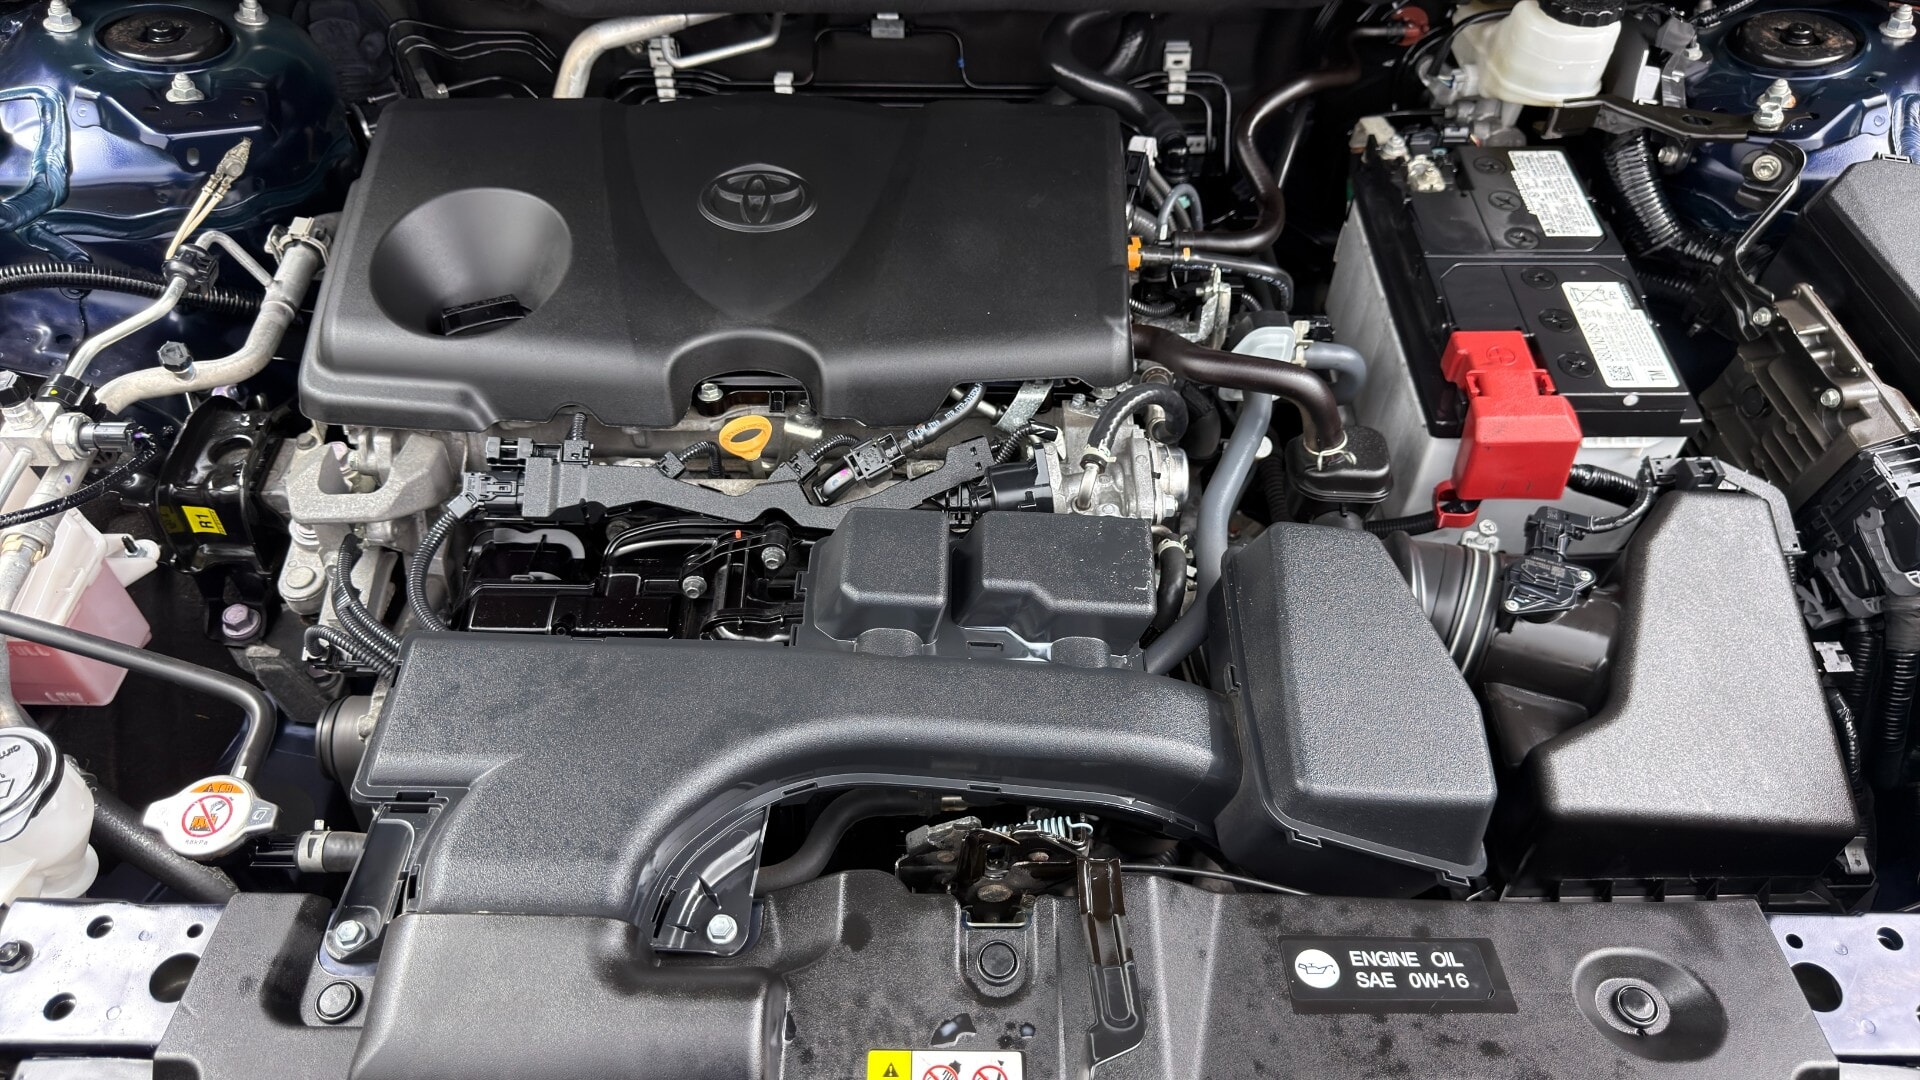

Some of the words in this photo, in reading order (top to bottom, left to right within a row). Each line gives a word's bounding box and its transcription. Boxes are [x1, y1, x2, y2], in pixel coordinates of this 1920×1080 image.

[194, 514, 215, 529] R1
[1349, 950, 1421, 967] ENGINE
[1430, 951, 1465, 967] OIL
[1355, 971, 1397, 988] SAE
[1408, 972, 1470, 989] 0W-16
